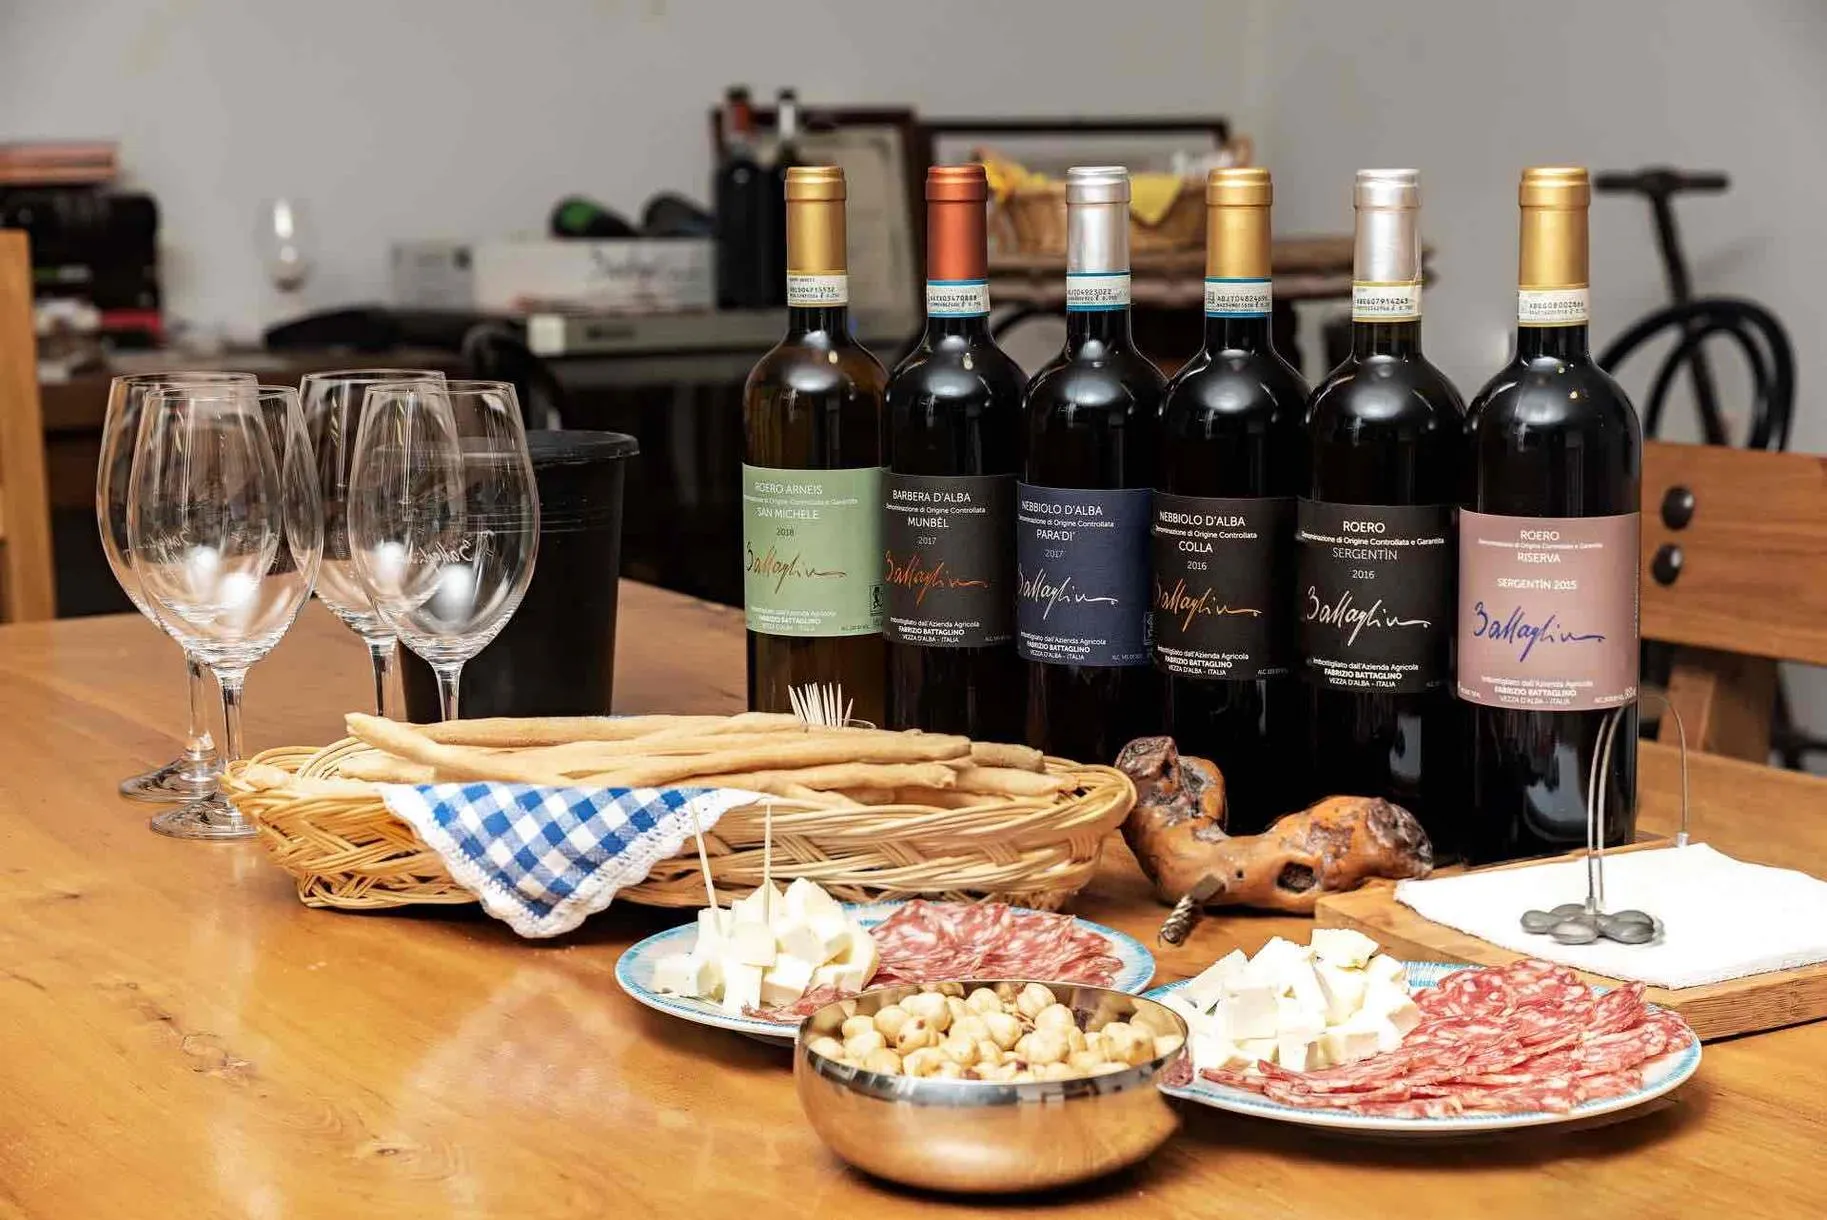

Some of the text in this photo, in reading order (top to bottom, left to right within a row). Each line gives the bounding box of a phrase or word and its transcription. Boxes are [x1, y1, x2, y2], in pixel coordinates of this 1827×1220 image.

[786, 484, 823, 496] ARNEIS
[892, 489, 972, 503] BARBERA D'ALBA
[756, 506, 820, 520] SAN MICHELE
[926, 507, 949, 515] Origine
[1021, 500, 1103, 516] NEBBIOLO D'ALBA
[1053, 520, 1077, 528] Origine
[1077, 520, 1115, 528] Controllata
[1159, 511, 1246, 527] NEBBIOLO D'ALBA
[776, 527, 794, 537] 2018
[1342, 520, 1386, 534] ROERO
[1194, 530, 1218, 539] Origine
[1219, 531, 1258, 540] Controllata
[1520, 530, 1560, 541] ROERO
[918, 536, 937, 545] 2017
[1343, 536, 1369, 546] Origine
[1369, 537, 1410, 546] Controllata
[1416, 537, 1445, 546] Garantita
[1178, 541, 1214, 553] COLLA
[1044, 549, 1064, 558] 2017
[1517, 552, 1561, 564] RISERVA
[1187, 561, 1208, 571] 2016
[1352, 569, 1375, 580] 2016
[954, 621, 980, 629] Agricola
[923, 627, 965, 636] BATTAGLINO
[1080, 638, 1107, 646] Agricola
[1049, 643, 1091, 653] BATTAGLINO
[1221, 652, 1250, 661] Agricola
[1189, 659, 1233, 669] BATTAGLINO
[1391, 663, 1419, 673] Agricola
[1207, 668, 1227, 676] ITALIA
[1324, 668, 1403, 680] FABRIZIO BATTAGLINO
[1328, 677, 1347, 685] VEZZA
[1528, 687, 1577, 698] BATTAGLINO
